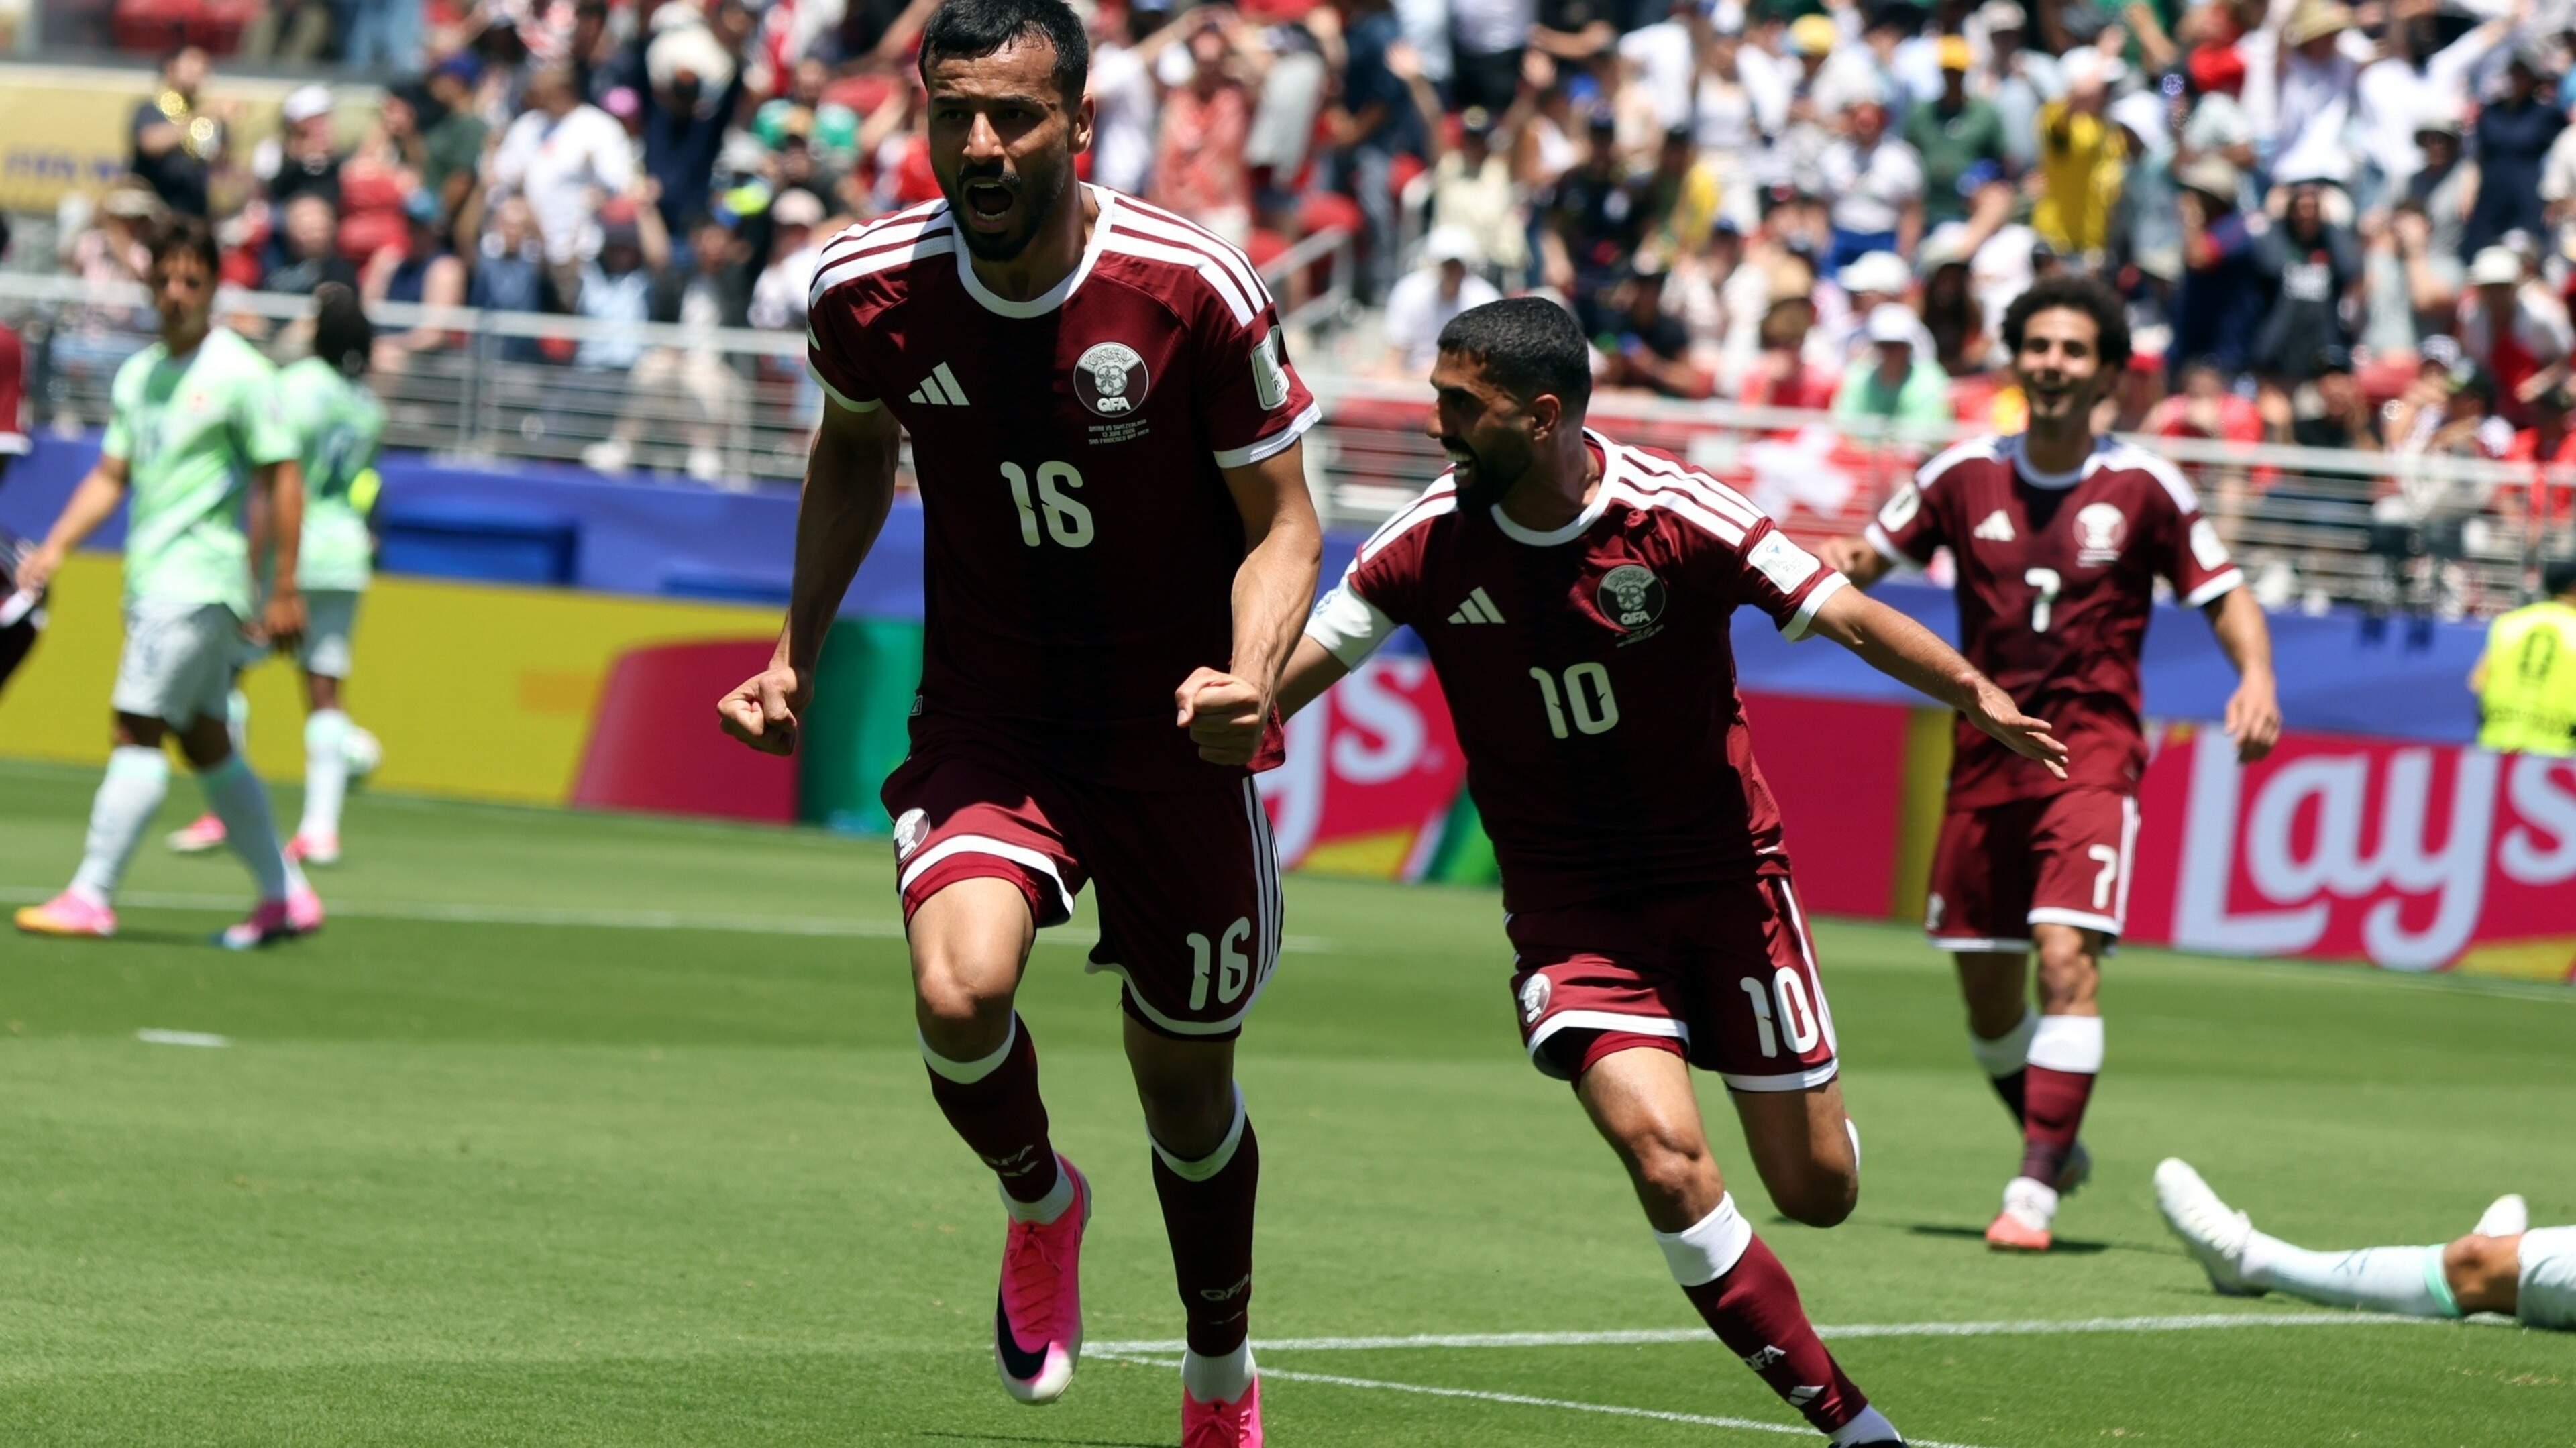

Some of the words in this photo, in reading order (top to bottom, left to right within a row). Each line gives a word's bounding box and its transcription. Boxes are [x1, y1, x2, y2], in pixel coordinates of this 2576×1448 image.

[1097, 396, 1132, 412] QFA
[1000, 461, 1095, 548] 16
[1620, 610, 1650, 625] QFA
[2025, 568, 2061, 633] 7
[1529, 662, 1619, 739] 10
[2088, 844, 2118, 909] 7
[1186, 916, 1251, 1011] 16
[1739, 966, 1819, 1058] 10
